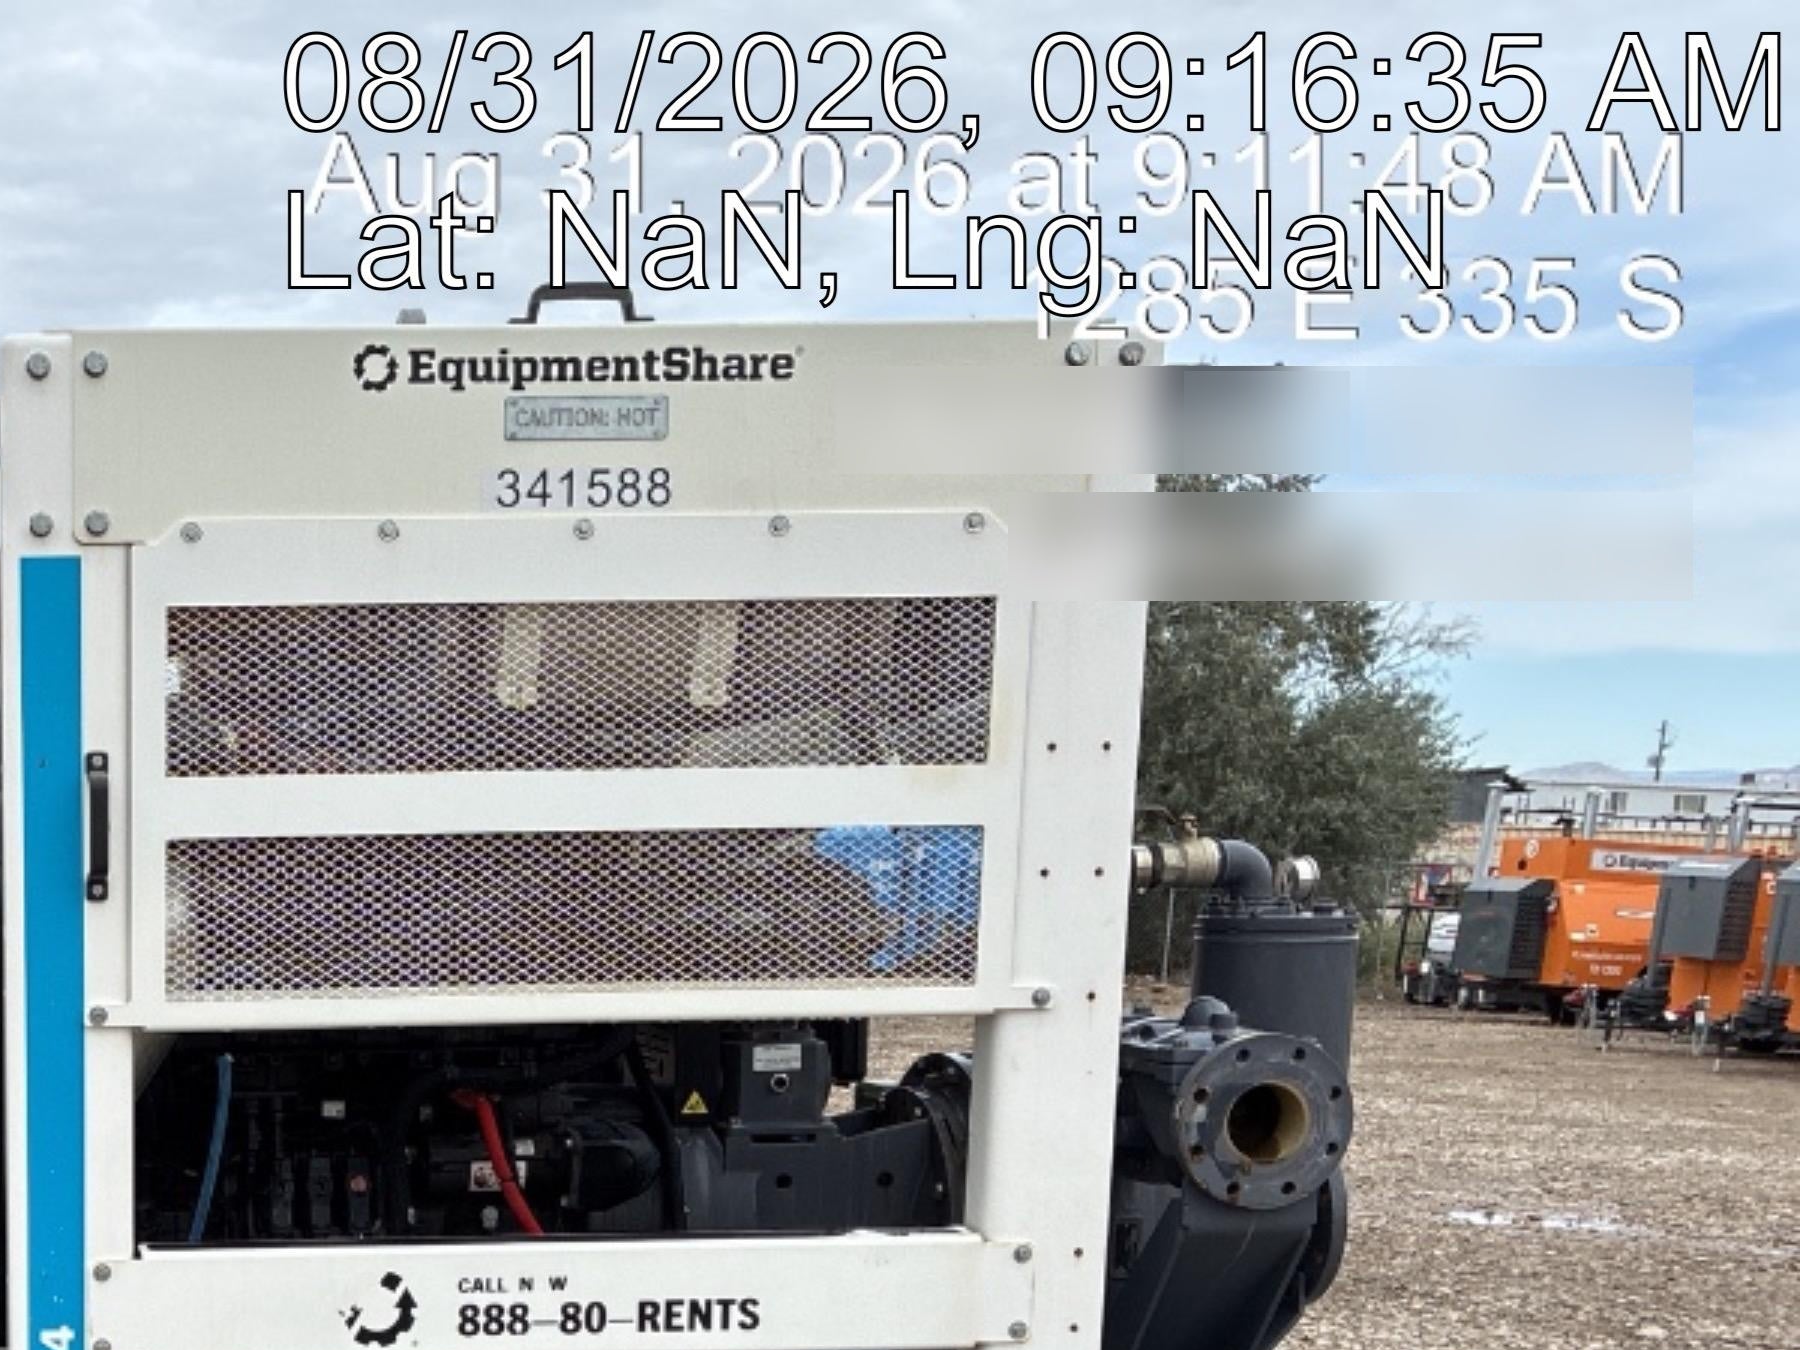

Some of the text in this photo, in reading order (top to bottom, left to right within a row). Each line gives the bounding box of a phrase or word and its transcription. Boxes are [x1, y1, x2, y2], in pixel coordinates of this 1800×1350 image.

[407, 346, 796, 391] EquipmentShare
[513, 405, 661, 428] CAUTION: HOT
[496, 467, 673, 508] 341588
[457, 1276, 507, 1294] CALL
[457, 1297, 761, 1337] 888-80-RENTS
